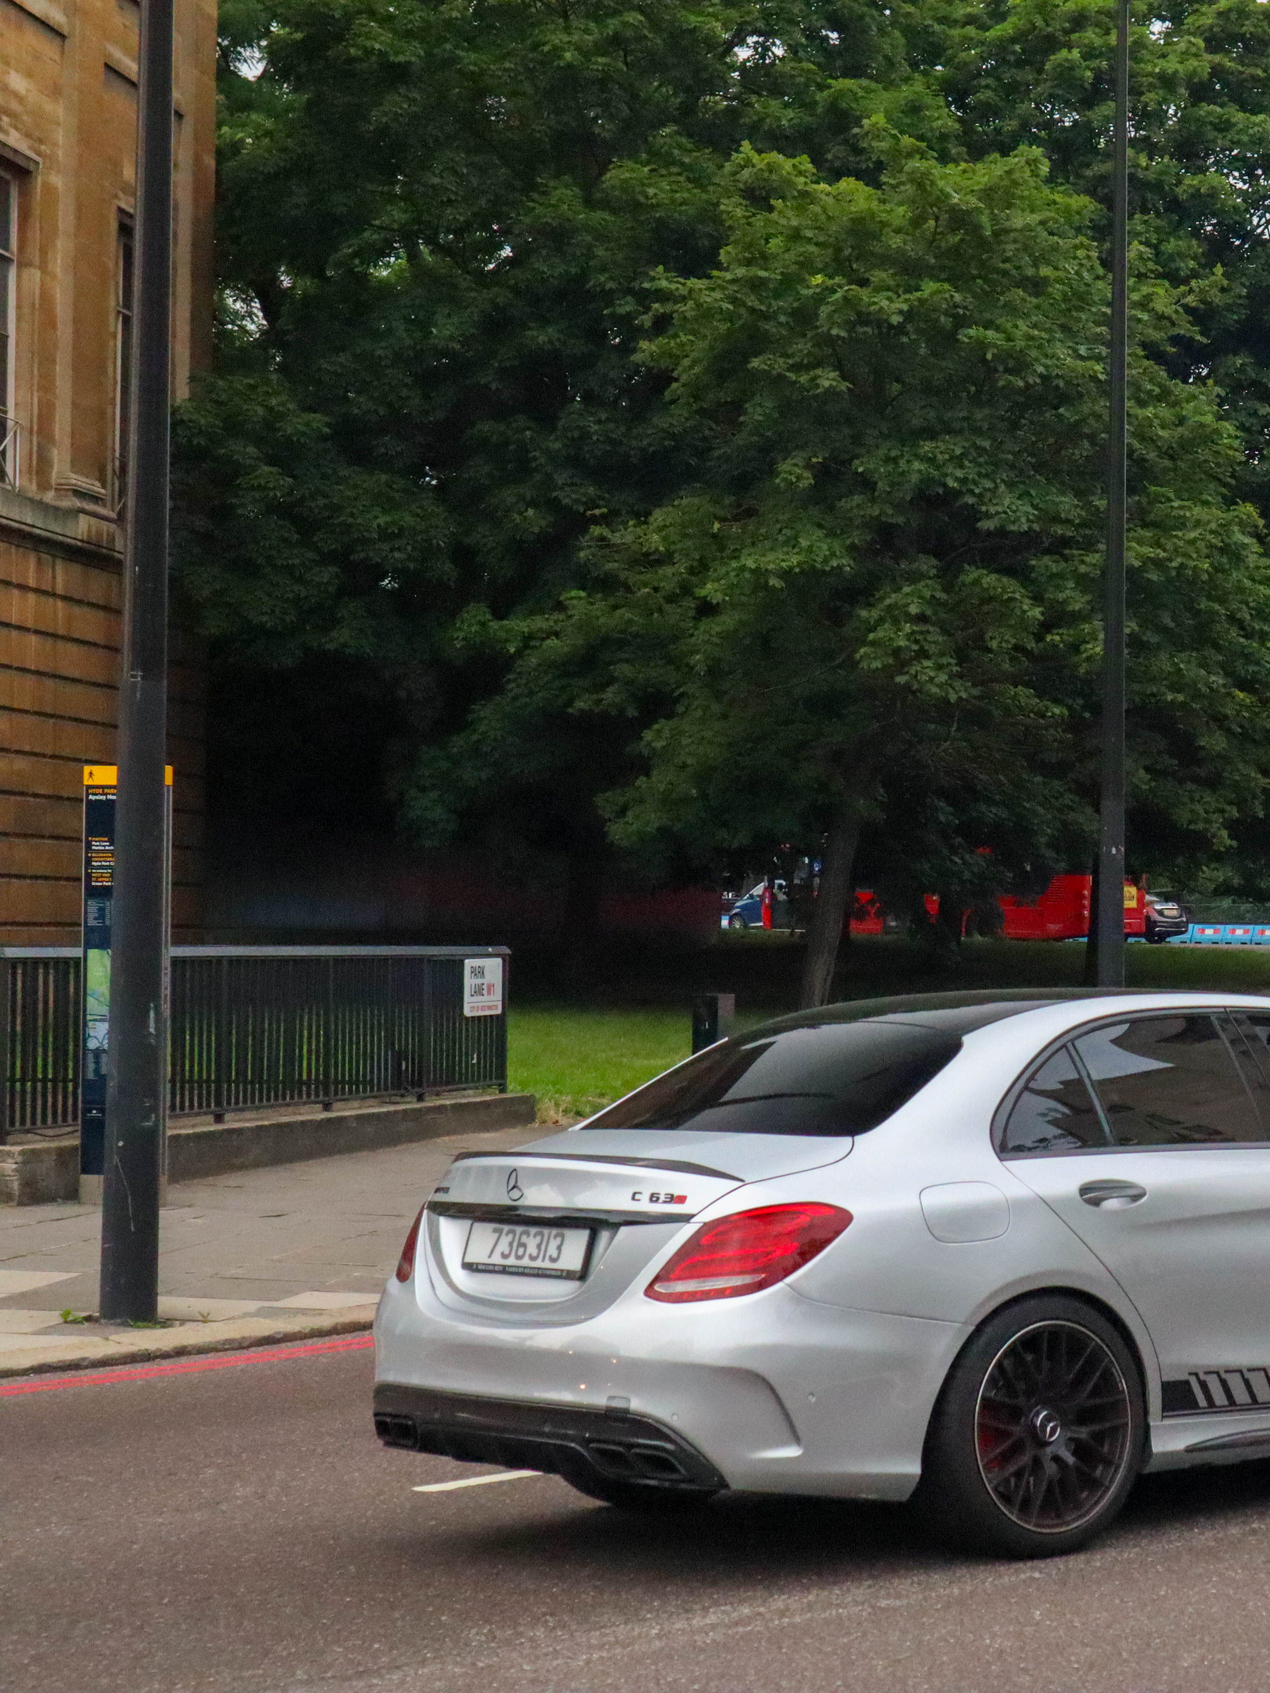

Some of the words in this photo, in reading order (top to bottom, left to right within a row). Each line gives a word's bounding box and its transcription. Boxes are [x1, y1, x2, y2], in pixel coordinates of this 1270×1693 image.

[470, 965, 486, 980] PARK
[470, 983, 485, 997] LANE
[486, 983, 495, 996] W1
[631, 1191, 643, 1201] C
[488, 1227, 565, 1264] 736313
